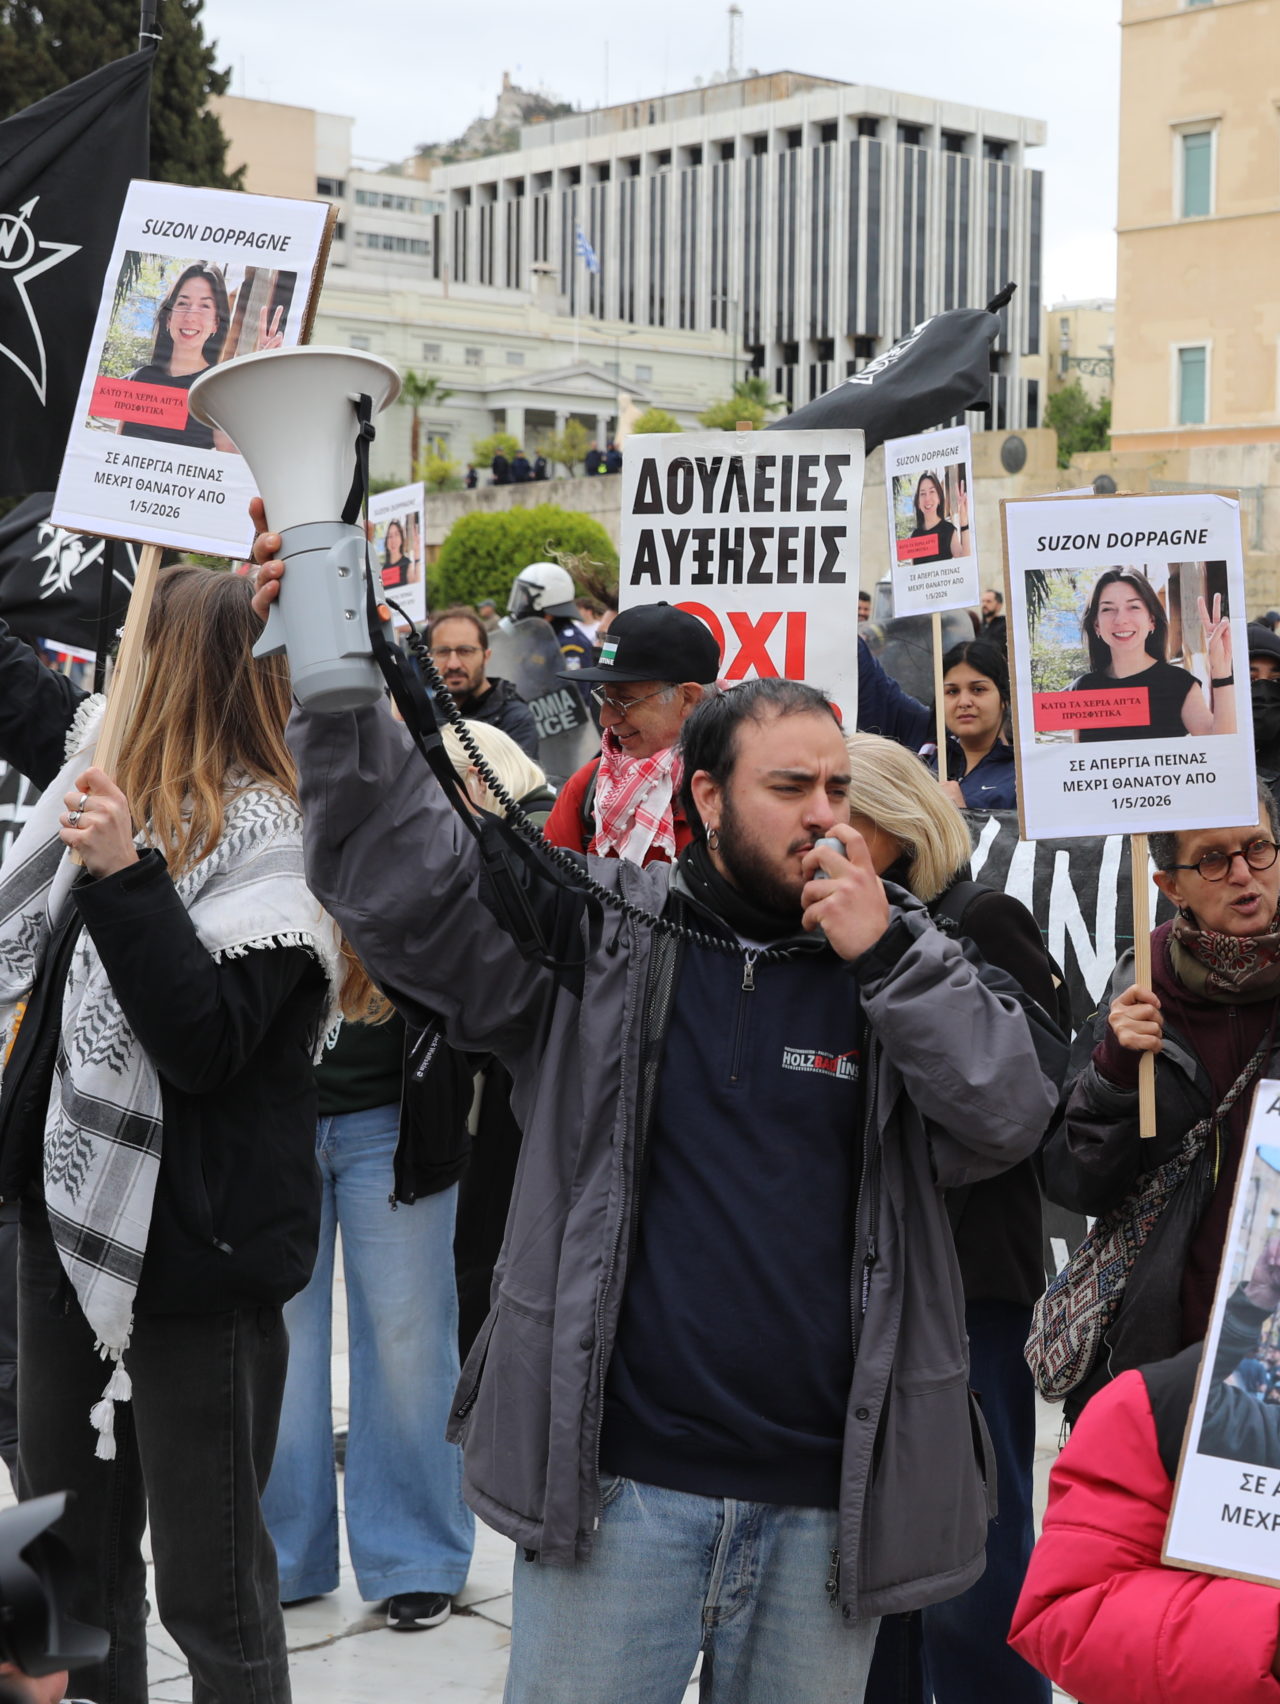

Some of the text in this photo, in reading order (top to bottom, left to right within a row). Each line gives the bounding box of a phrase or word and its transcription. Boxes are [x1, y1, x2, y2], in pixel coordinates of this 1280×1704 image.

[142, 218, 291, 251] SUZON DOPPAGNE
[123, 391, 133, 400] ΤΑ
[135, 393, 158, 403] ΧΕΡΙΑ
[114, 401, 164, 415] ΠΡΟΣΦΥΓΙΚΑ
[105, 451, 224, 482] ΣΕ ΑΠΕΡΓΙΑ ΠΕΙΝΑΣ
[896, 446, 959, 467] SUZON DOPPAGNE
[94, 471, 226, 505] ΜΕΧΡΙ ΘΑΝΑΤΟΥ ΑΠΟ
[631, 454, 851, 515] ΔΟΥΛΕΙΕΣ
[130, 499, 181, 519] 1/5/2026
[1037, 529, 1208, 552] SUZON DOPPAGNE
[629, 526, 847, 586] ΑΥΞΗΣΕΙΣ
[1041, 702, 1067, 710] ΚΑΤΩ
[1083, 699, 1111, 707] ΧΕΡΙΑ
[1062, 709, 1122, 720] ΠΡΟΣΦΥΓΙΚΑ
[1069, 752, 1207, 772] ΣΕ ΑΠΕΡΓΙΑ ΠΕΙΝΑΣ
[1063, 772, 1217, 792] ΜΕΧΡΙ ΘΑΝΑΤΟΥ ΑΠΟ
[1111, 795, 1172, 810] 1/5/2026
[1239, 1472, 1268, 1494] ΣΕ
